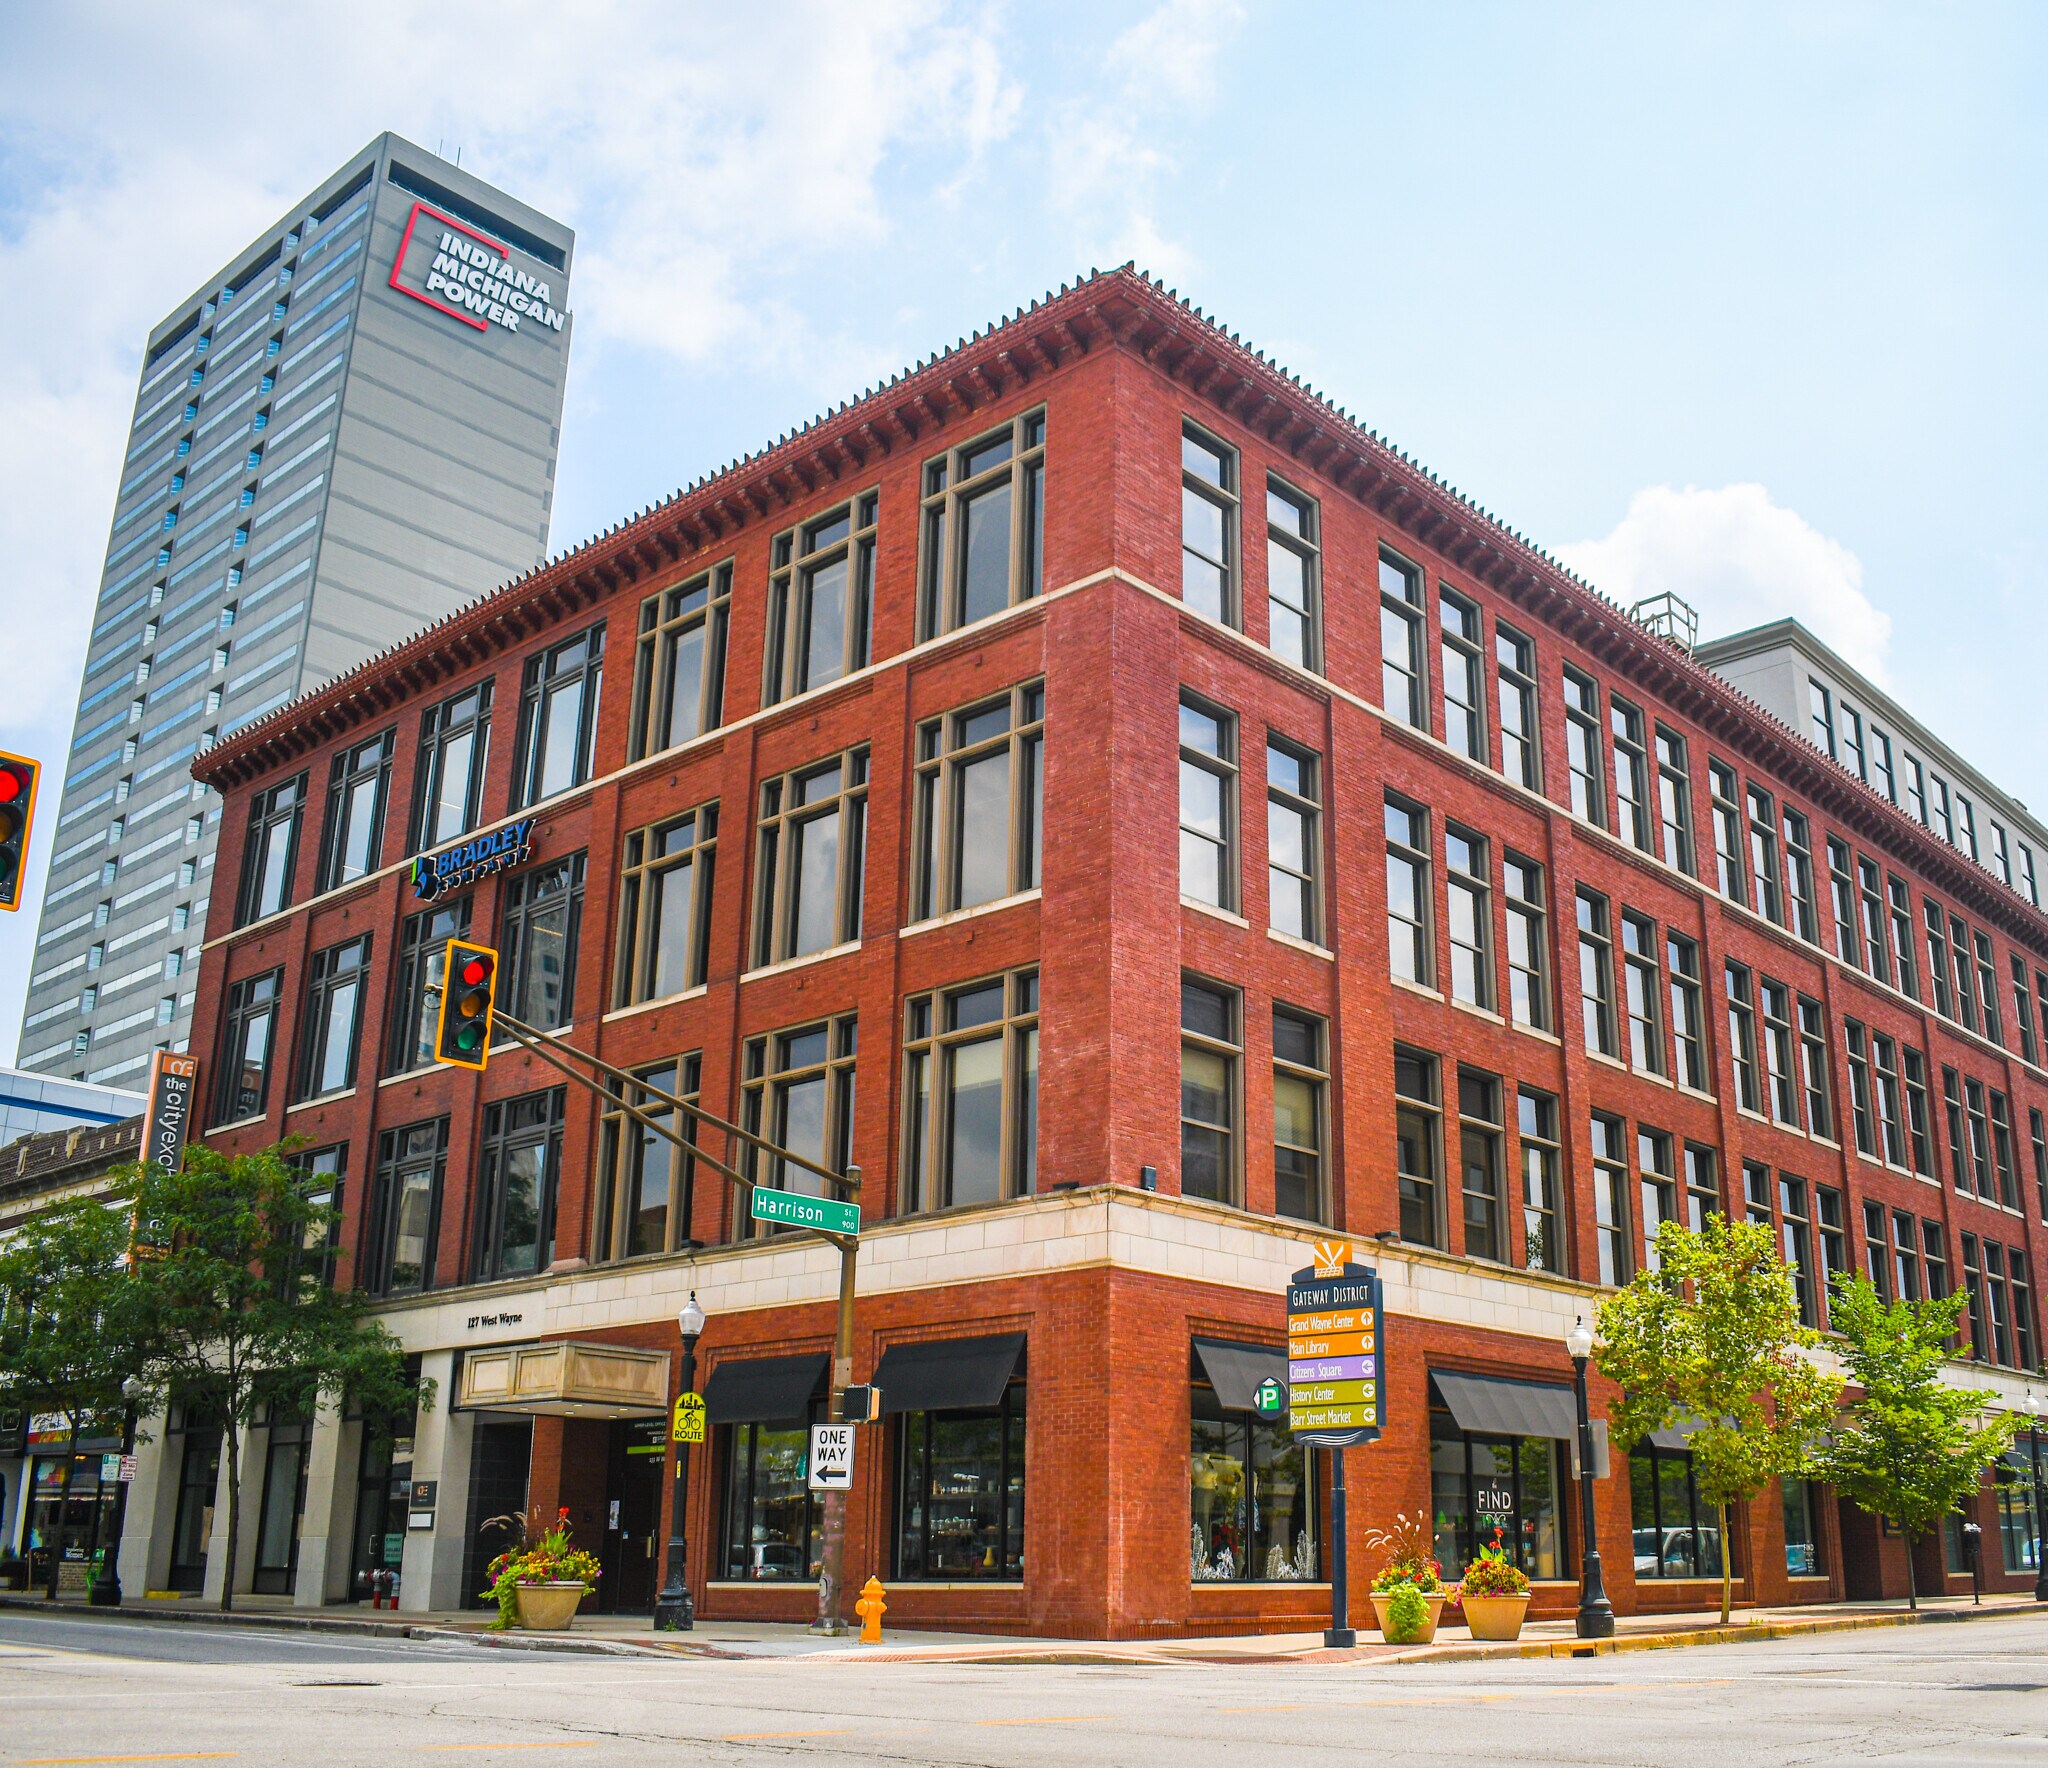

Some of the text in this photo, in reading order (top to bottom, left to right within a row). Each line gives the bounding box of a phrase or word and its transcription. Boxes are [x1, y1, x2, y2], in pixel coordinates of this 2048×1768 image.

[439, 232, 550, 304] INDIANA
[431, 253, 565, 331] MICHIGAN
[426, 272, 520, 332] POWER
[438, 819, 529, 876] BRADLEY
[165, 1077, 187, 1092] the
[757, 1195, 823, 1222] Harrison
[842, 1221, 855, 1230] 900
[1292, 1285, 1368, 1307] GATEWAY DISTRICT
[468, 1312, 522, 1328] 127 West Wayne
[1289, 1314, 1354, 1332] Grand Wayne Center
[1289, 1339, 1330, 1355] Main Library
[1290, 1363, 1342, 1379] Citizens Square
[1262, 1389, 1277, 1408] P
[1289, 1386, 1335, 1404] History Center
[1290, 1408, 1351, 1426] Barr Street Market
[674, 1430, 702, 1440] ROUTE
[819, 1430, 847, 1444] ONE
[817, 1447, 847, 1461] WAY
[1478, 1490, 1511, 1509] FIND
